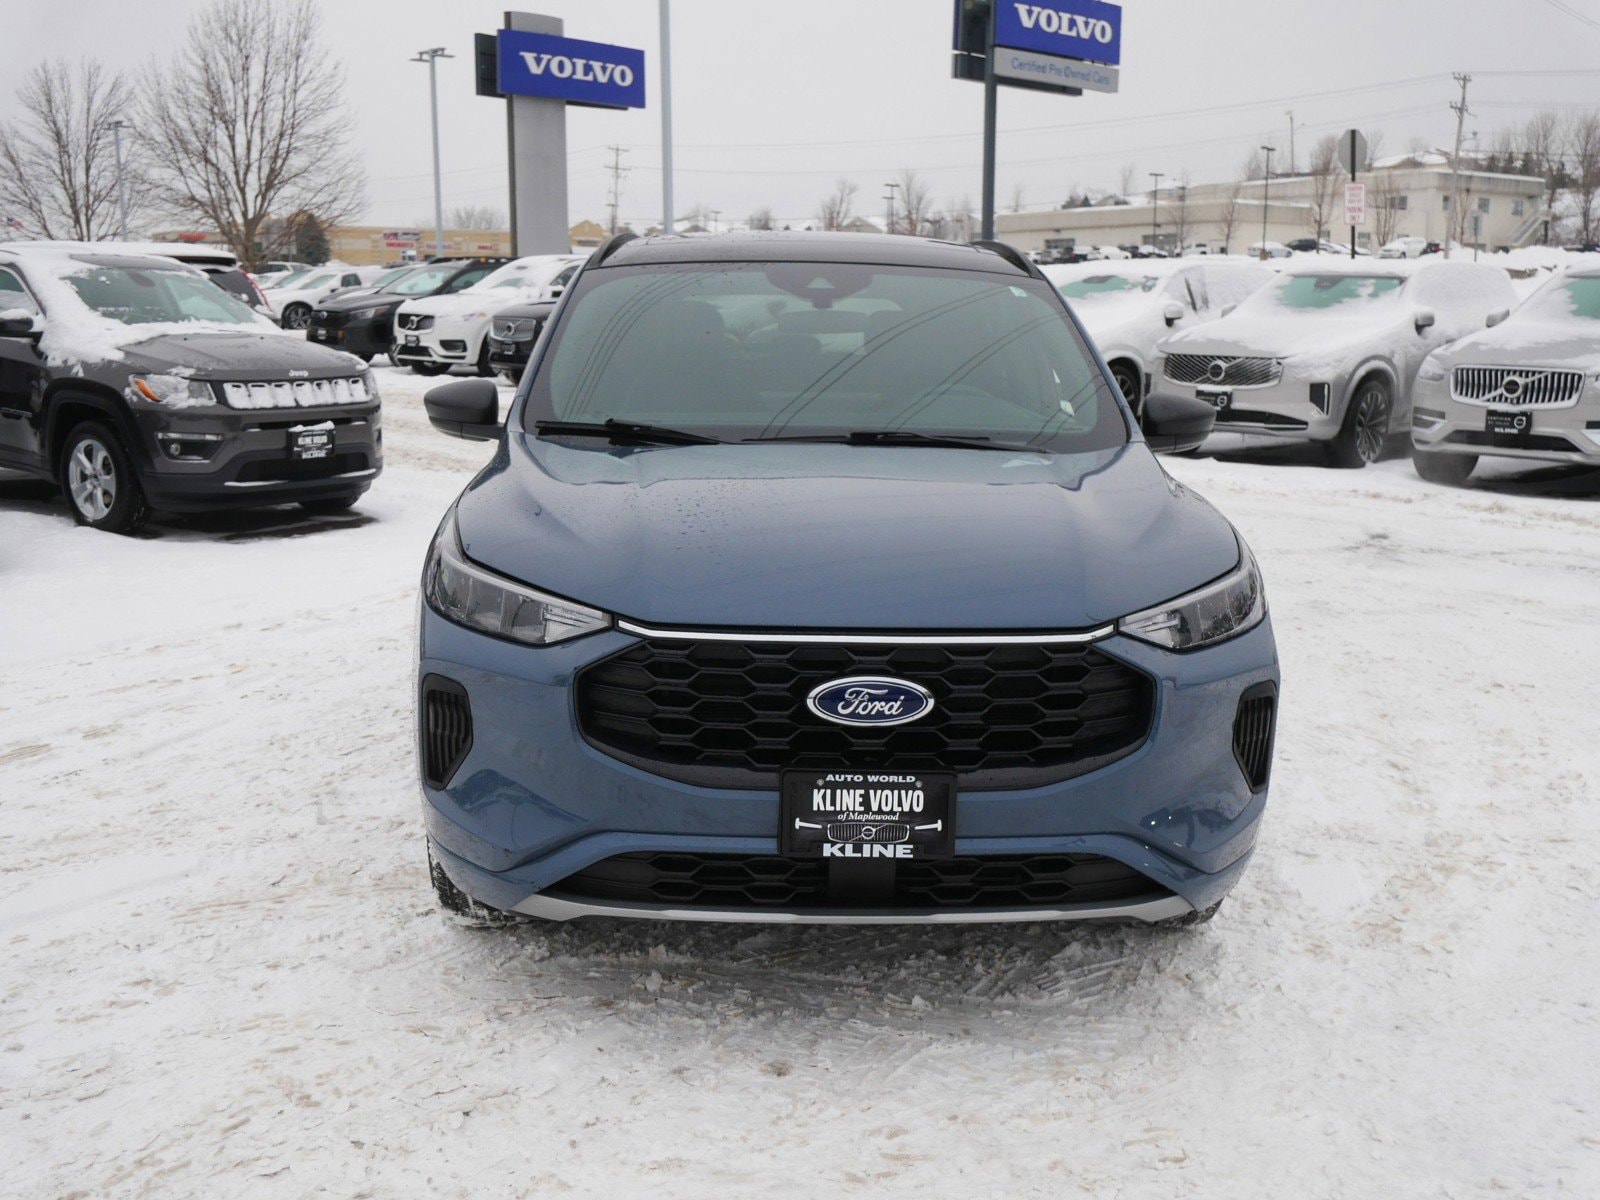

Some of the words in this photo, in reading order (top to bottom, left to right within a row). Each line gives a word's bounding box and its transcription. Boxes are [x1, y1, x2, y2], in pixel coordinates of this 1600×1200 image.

[1014, 3, 1113, 44] VOLVO
[519, 51, 634, 87] VOLVO
[1011, 57, 1047, 74] Certified
[837, 687, 905, 715] Ford
[825, 774, 864, 783] AUTO
[867, 774, 916, 784] WORLD
[813, 789, 865, 811] KLINE
[869, 789, 924, 813] VOLVO
[837, 812, 848, 821] of
[848, 812, 900, 821] Maplewood
[822, 843, 914, 859] KLINE
